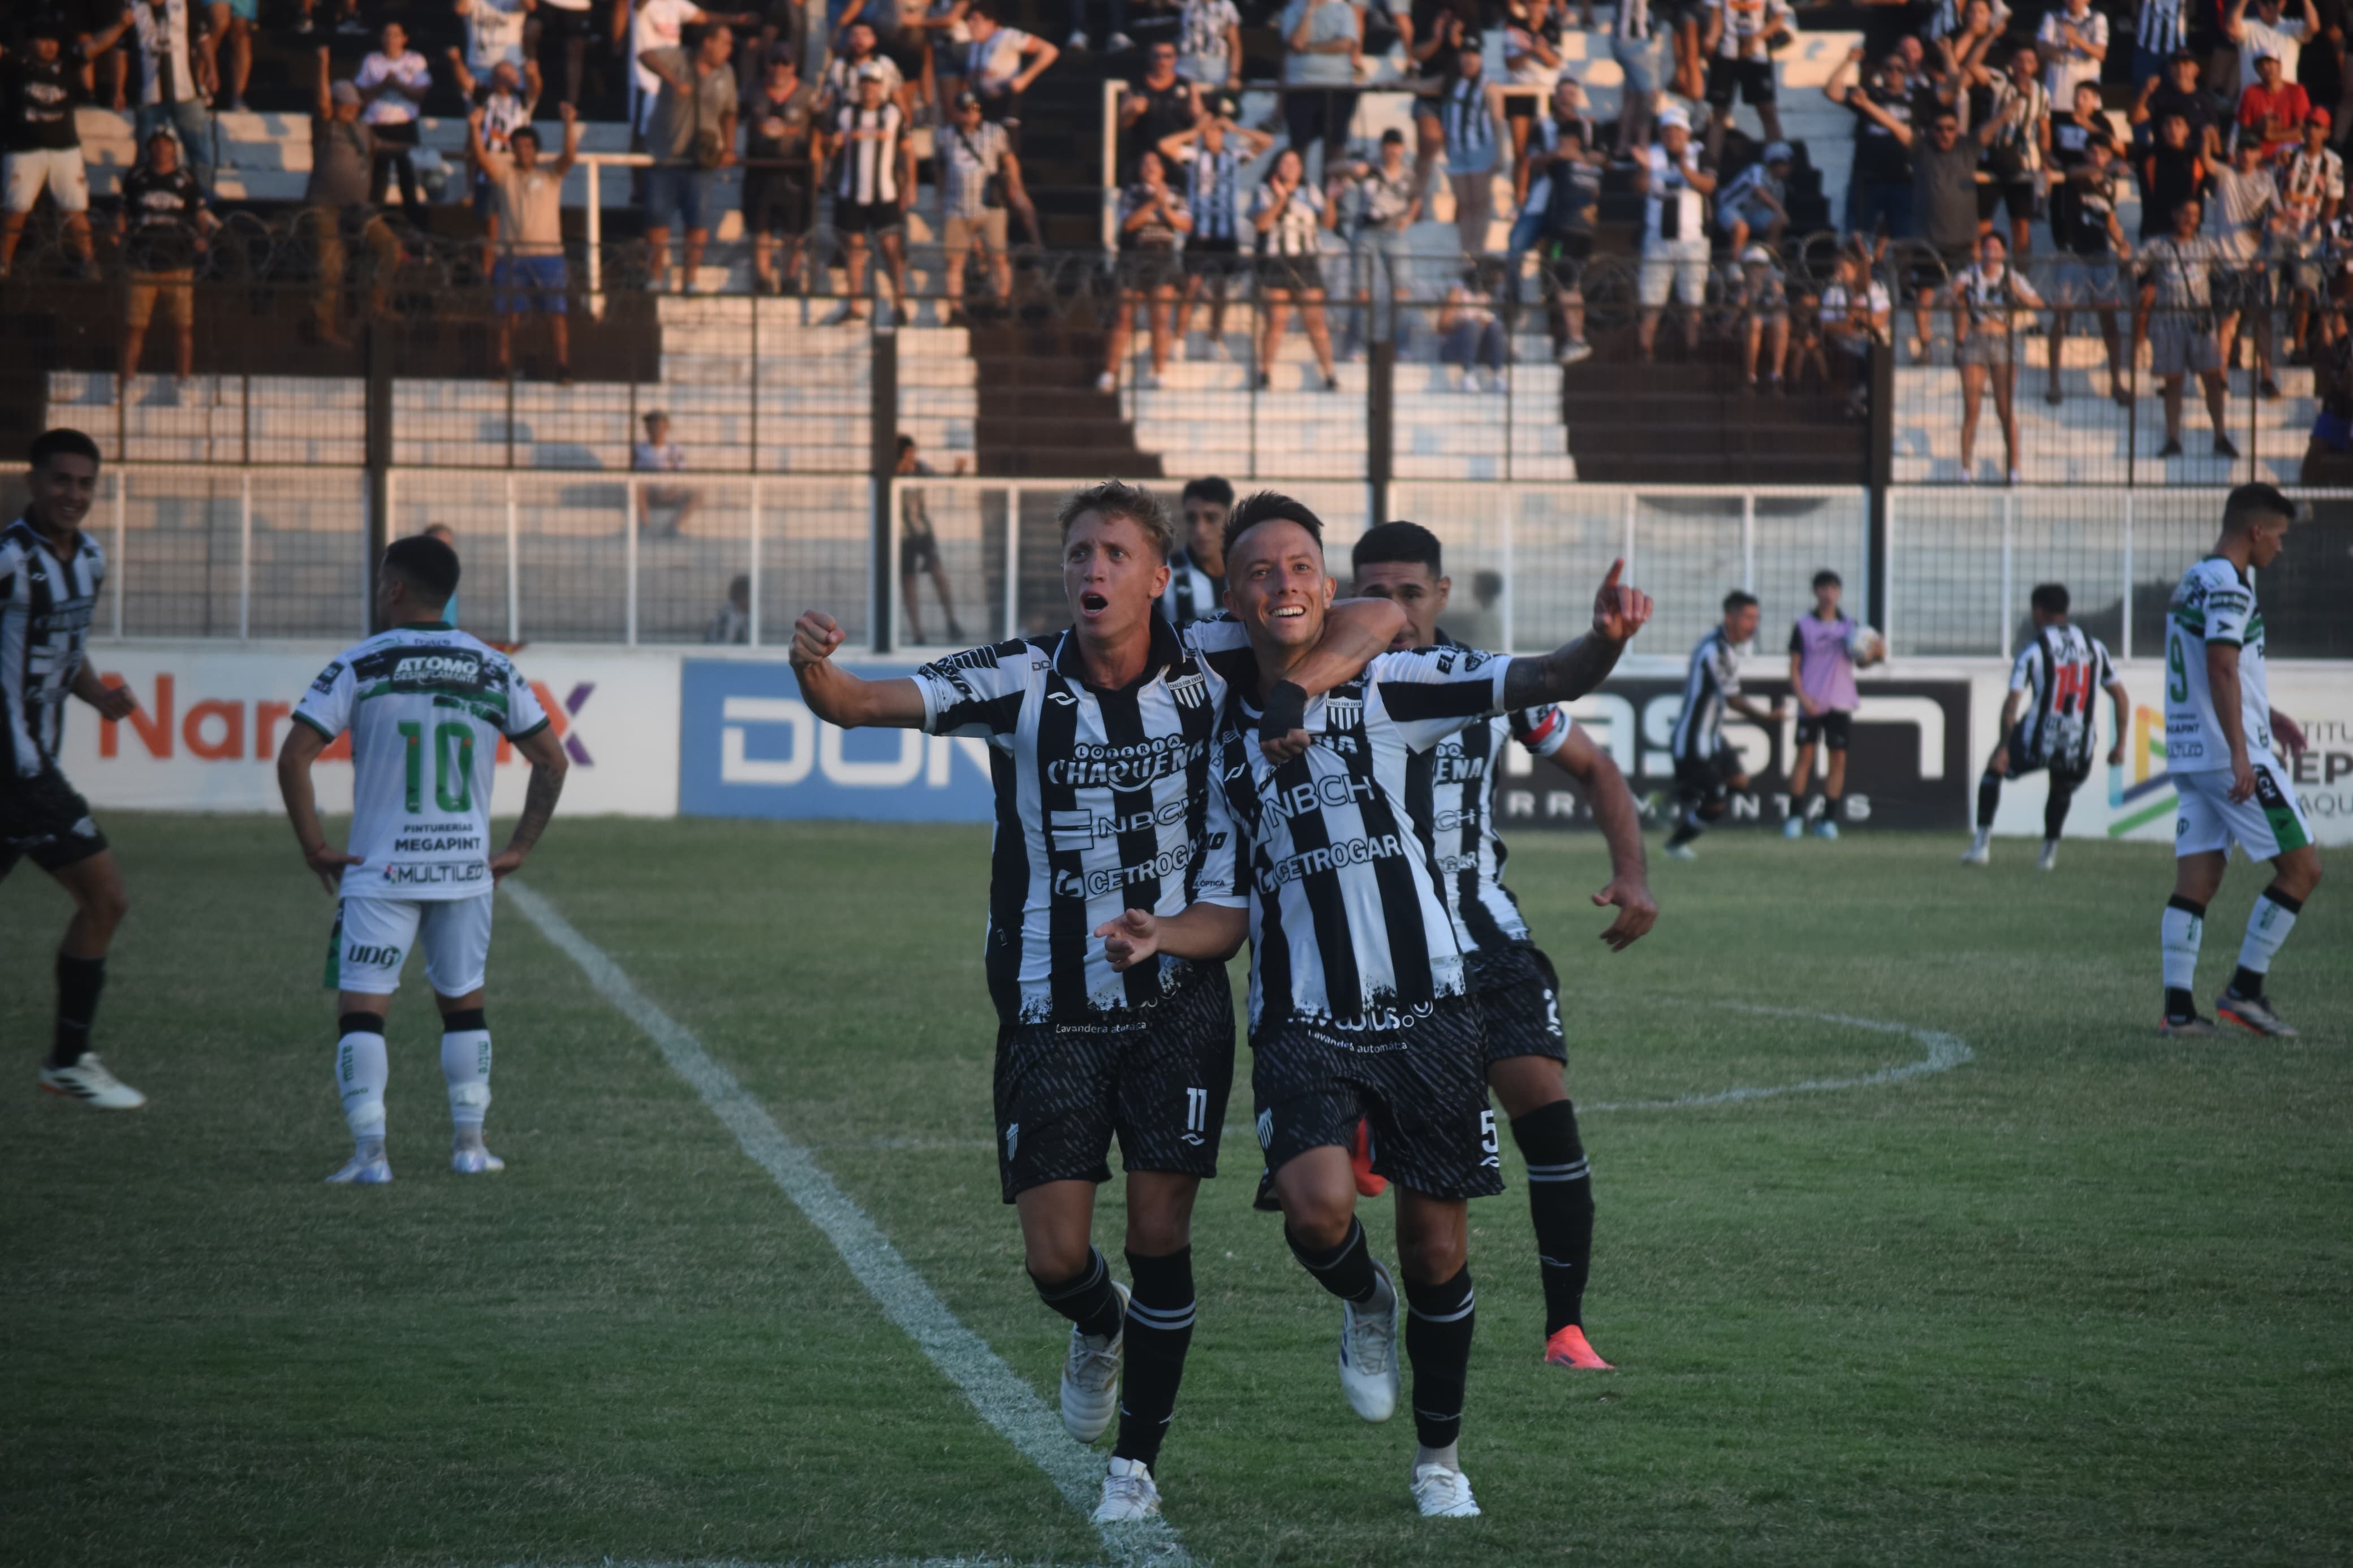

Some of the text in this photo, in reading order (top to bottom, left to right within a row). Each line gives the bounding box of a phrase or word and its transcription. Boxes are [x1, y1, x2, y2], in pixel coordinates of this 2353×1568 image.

[395, 655, 480, 676] ATOMO
[2054, 660, 2091, 714] 14
[2170, 633, 2188, 703] 9
[398, 720, 474, 814] 10
[1075, 735, 1180, 759] LOTERIA
[1265, 775, 1376, 828] NBCH
[394, 837, 481, 852] MEGAPINT
[1274, 833, 1402, 884] CETROGAR
[398, 865, 484, 883] MULTILED
[1187, 1087, 1208, 1132] 11
[1480, 1109, 1499, 1154] 5
